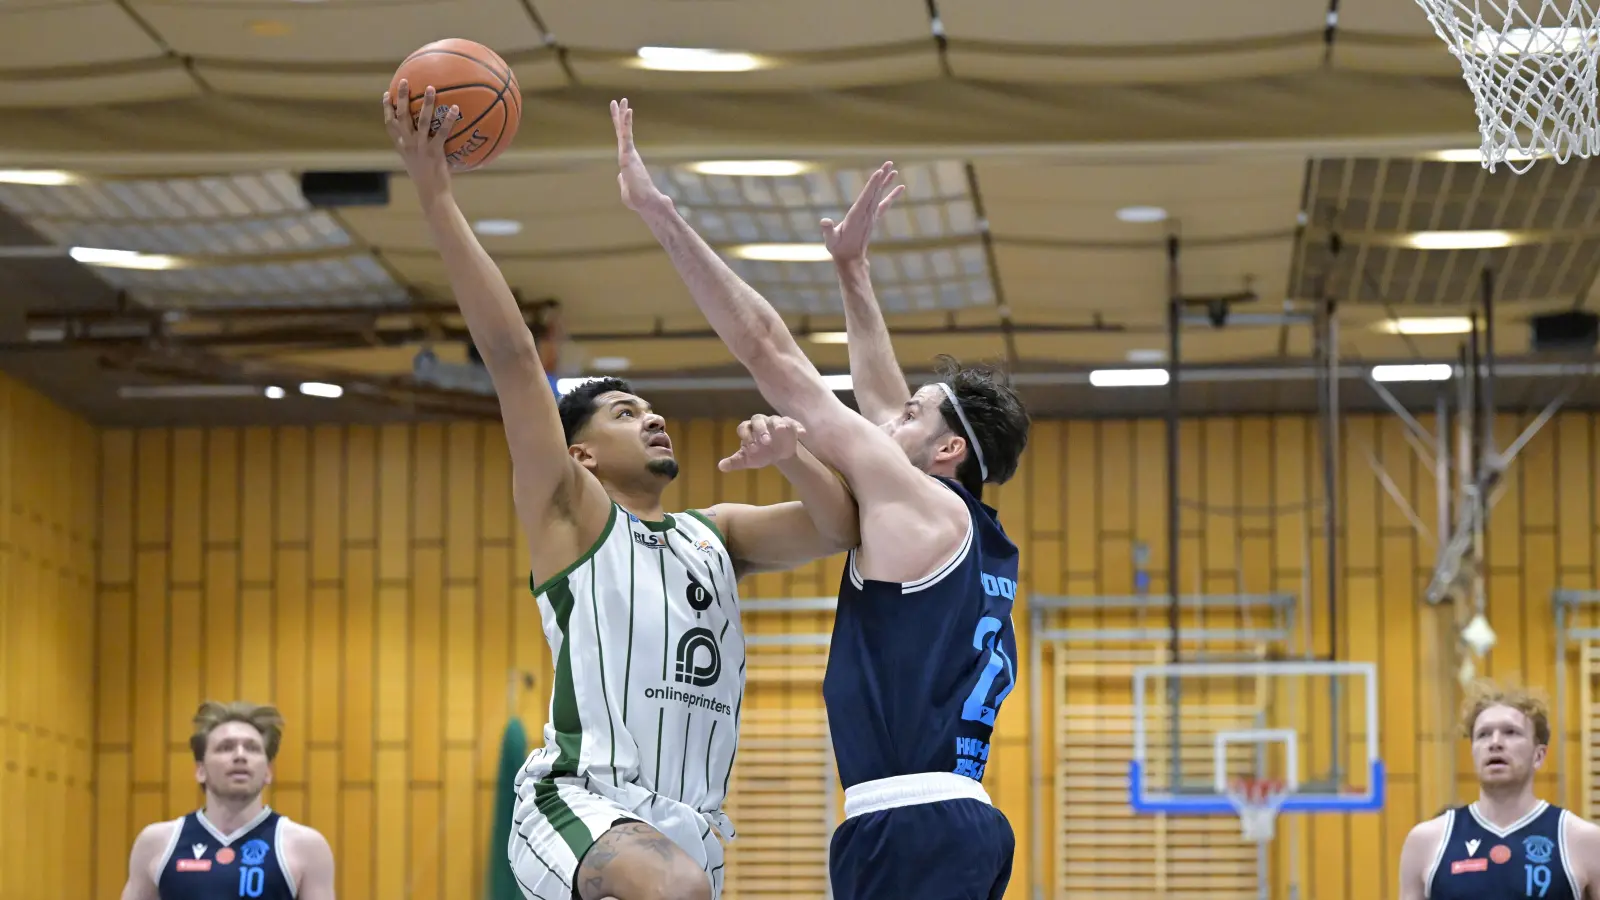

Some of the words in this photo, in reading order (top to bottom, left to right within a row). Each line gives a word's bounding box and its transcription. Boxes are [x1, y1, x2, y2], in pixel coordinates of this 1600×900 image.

[634, 531, 658, 546] RLS
[644, 686, 731, 716] onlineprinters
[239, 866, 265, 898] 10
[1524, 863, 1551, 897] 19
